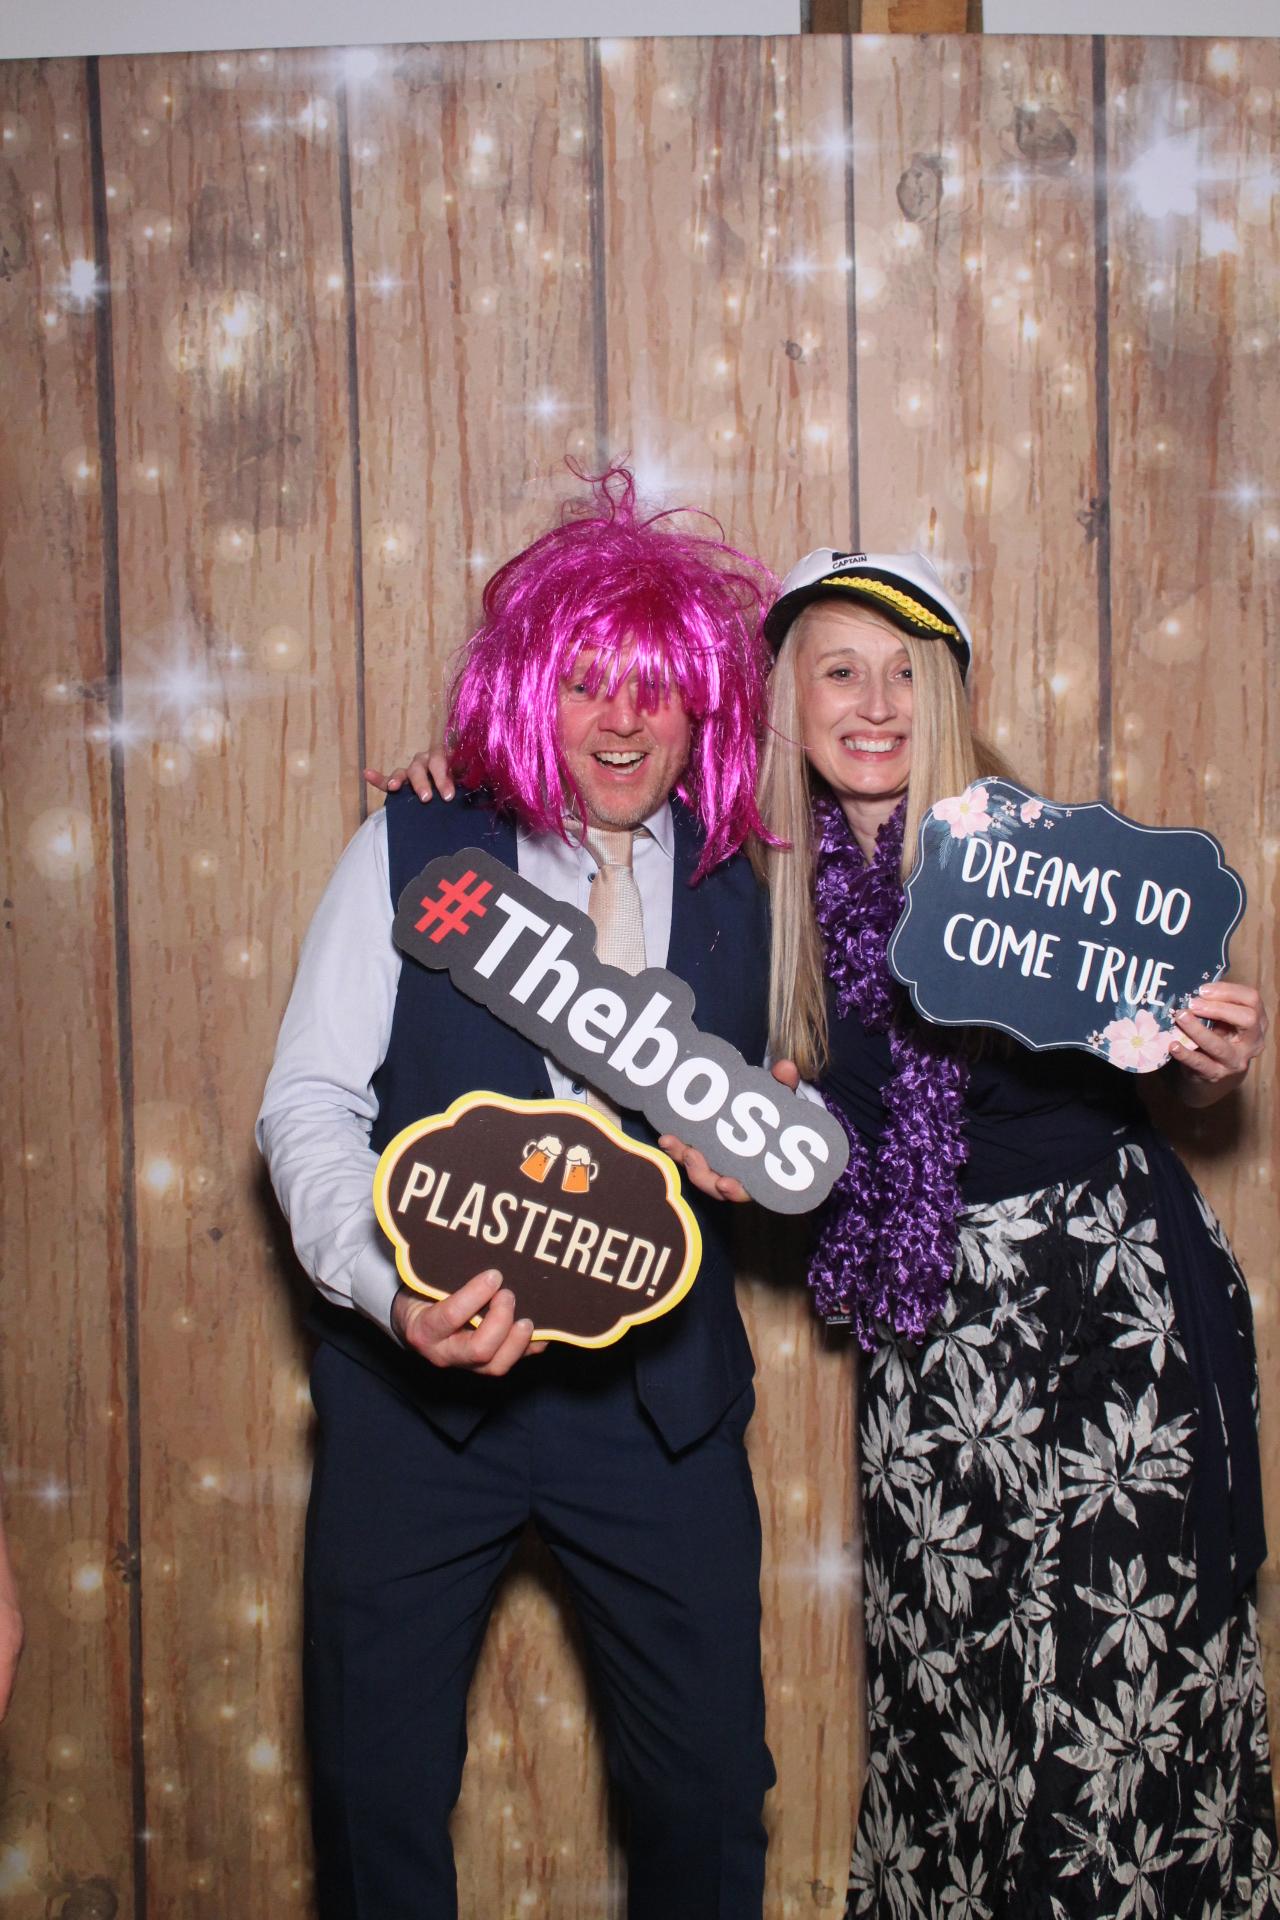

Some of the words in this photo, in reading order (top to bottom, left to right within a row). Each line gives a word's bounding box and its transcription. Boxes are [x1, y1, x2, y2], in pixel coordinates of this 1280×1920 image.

[832, 555, 867, 569] CAPTAIN
[961, 837, 1121, 926] DREAMS
[1135, 880, 1191, 935] DO
[943, 913, 1060, 979] COME
[1077, 940, 1174, 1007] TRUE
[414, 870, 830, 1192] #Theboss
[397, 1162, 672, 1298] PLASTERED!
